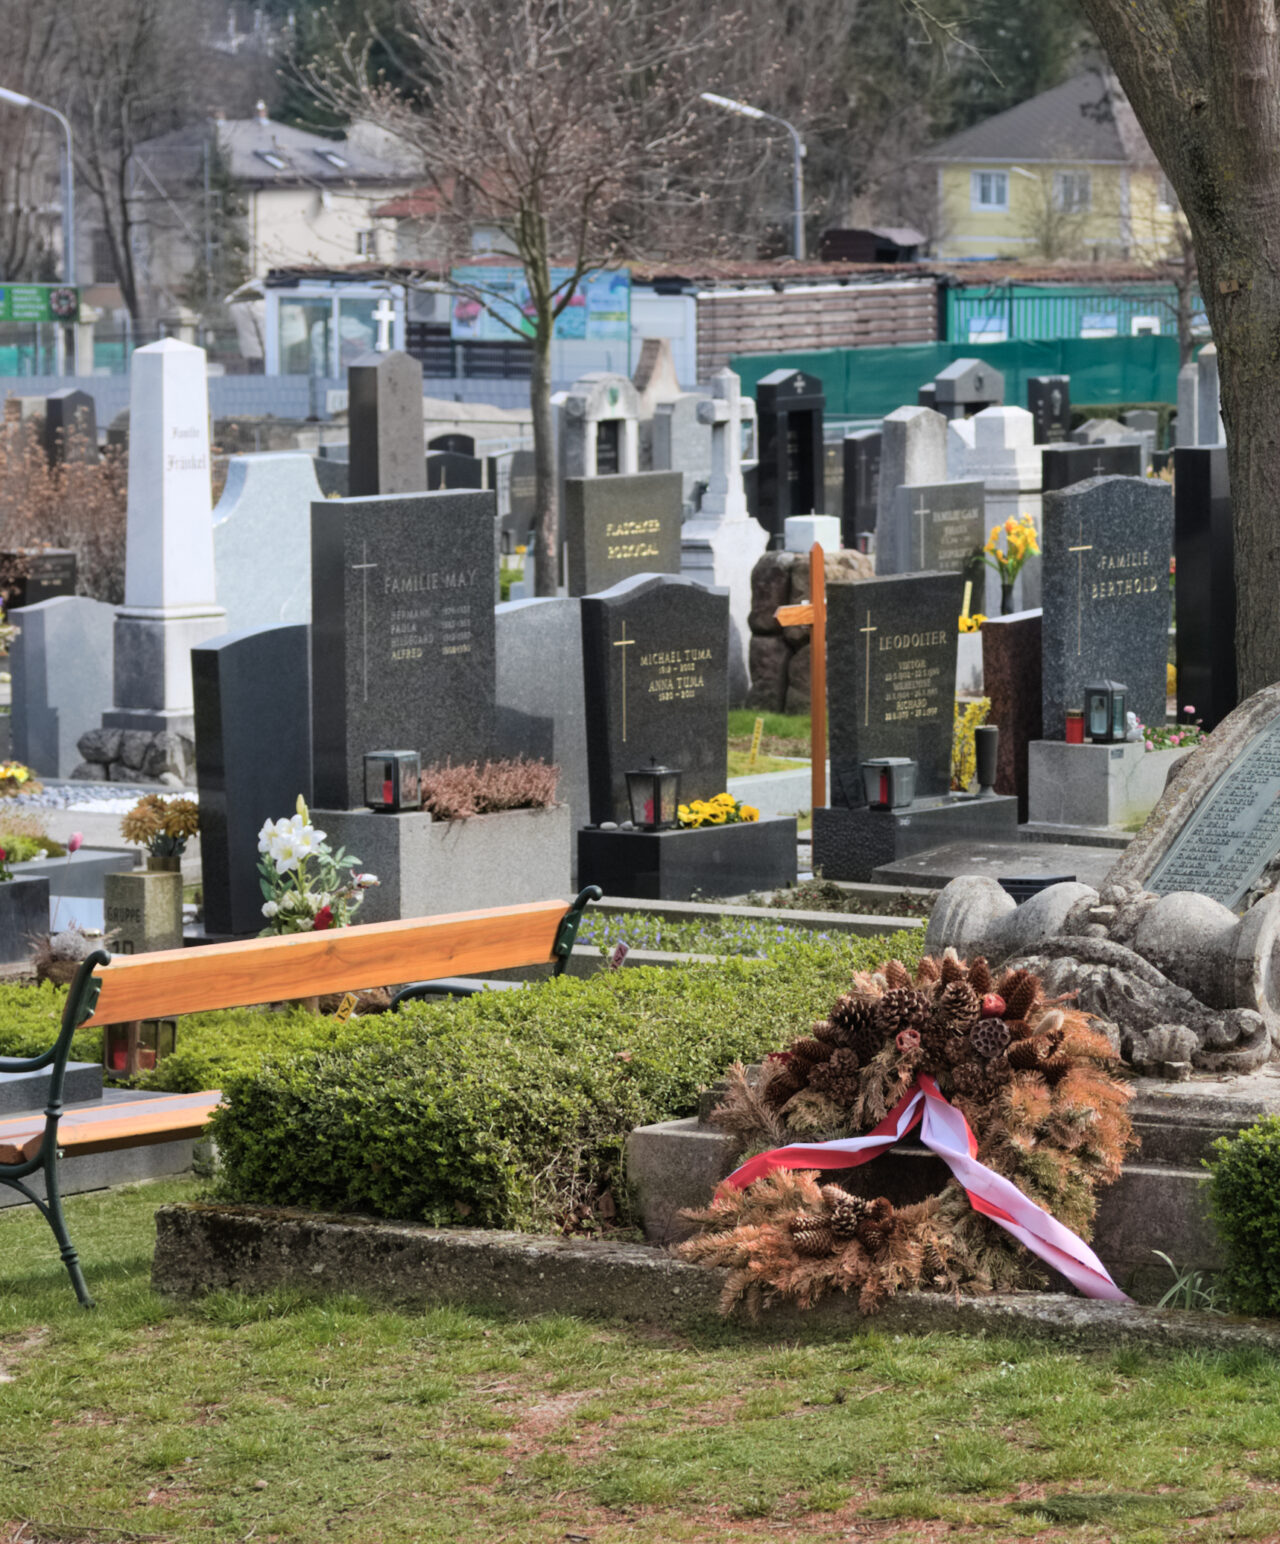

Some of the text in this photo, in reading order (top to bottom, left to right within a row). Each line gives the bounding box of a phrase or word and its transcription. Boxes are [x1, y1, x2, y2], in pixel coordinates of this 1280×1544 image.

[1101, 550, 1149, 569] FAMILIE
[384, 568, 478, 594] FAMILIE MAY
[1091, 576, 1158, 599] BERTHOLD
[879, 630, 947, 651] LEODOLTER
[640, 648, 712, 666] MICHAEL TUMA
[648, 675, 704, 692] ANNA TUMA
[107, 905, 141, 923] GRUPPE
